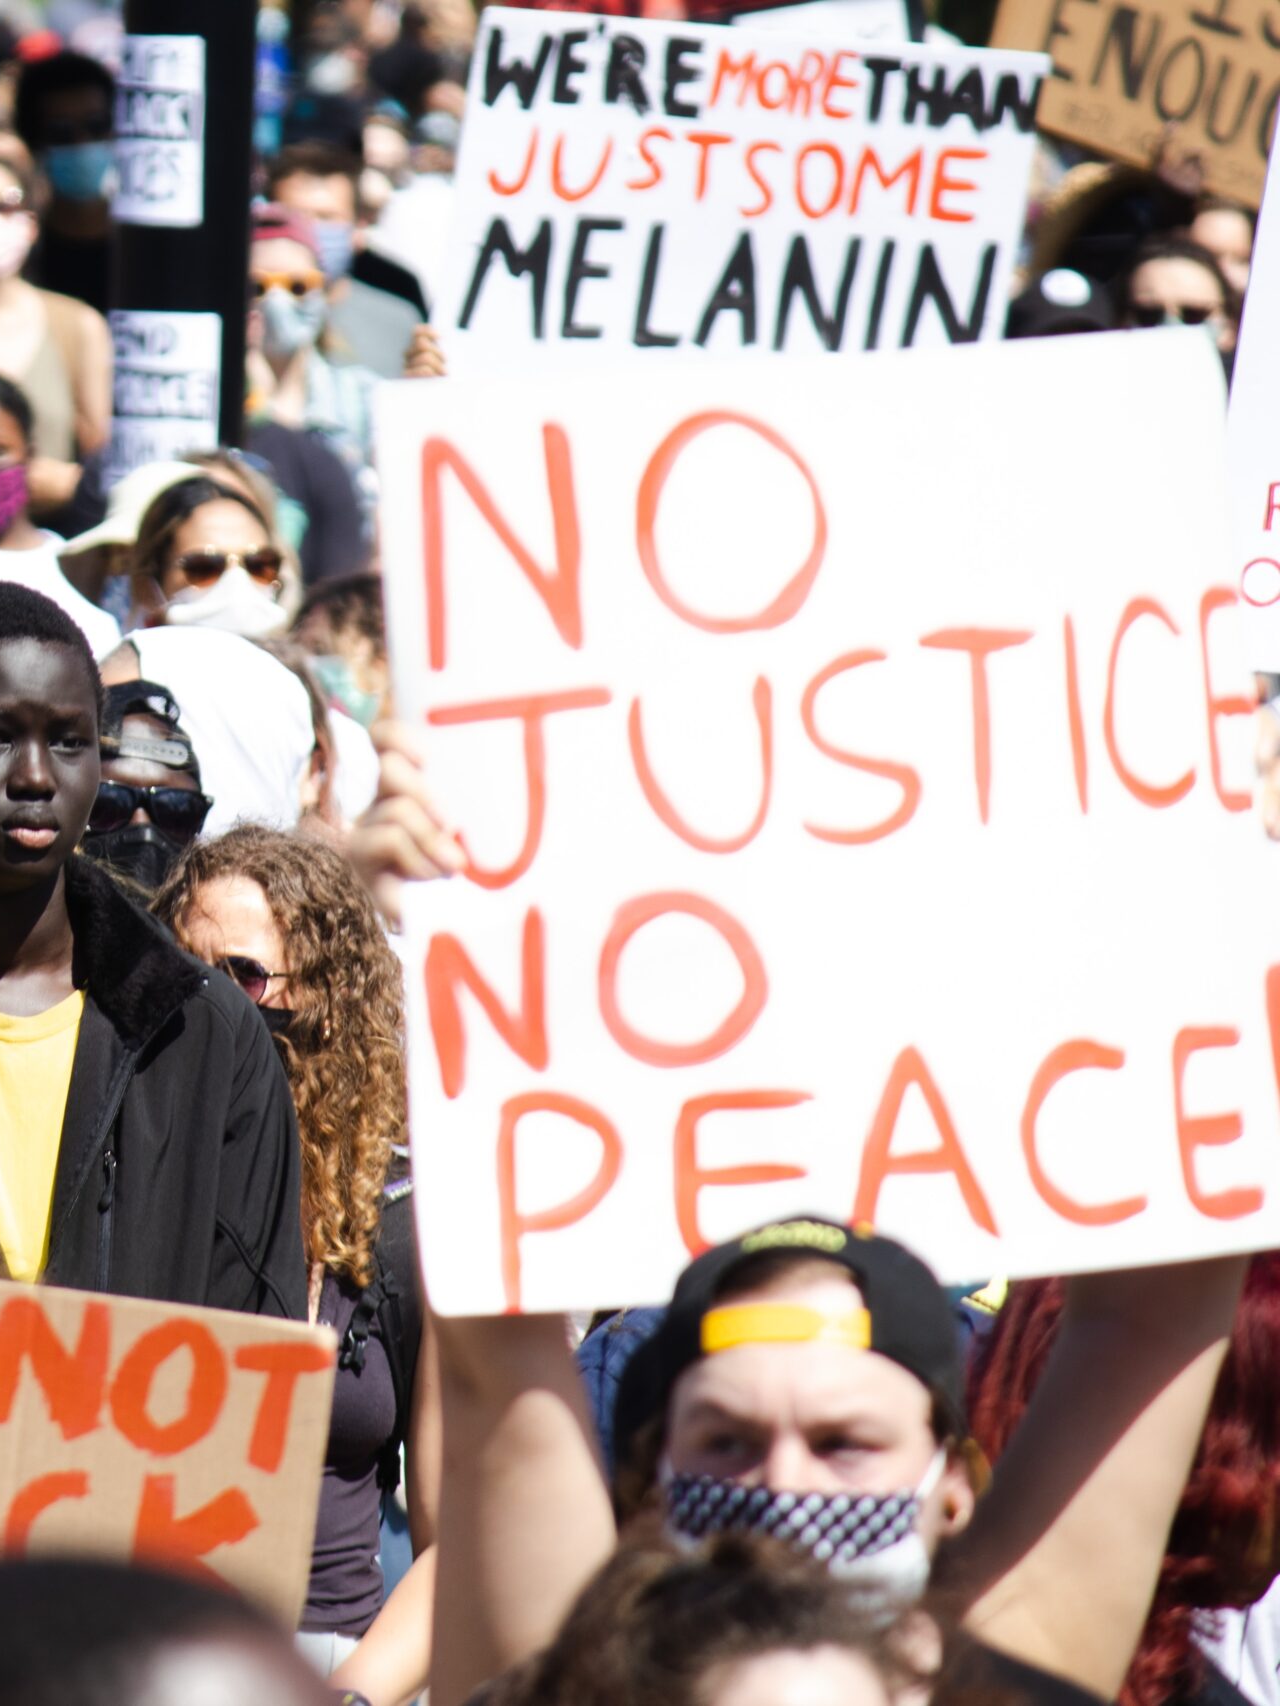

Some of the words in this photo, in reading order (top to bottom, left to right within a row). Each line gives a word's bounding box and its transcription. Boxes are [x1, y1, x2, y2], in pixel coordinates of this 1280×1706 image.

[483, 19, 703, 119] WE'RE
[706, 46, 860, 118] MORE
[863, 56, 1043, 137] THAN
[1043, 0, 1280, 160] ENOU
[488, 127, 732, 203] JUST
[739, 141, 988, 222] SOME
[458, 214, 998, 352] MELANIN
[421, 408, 829, 673] NO
[427, 585, 1259, 890] JUSTICE
[424, 889, 769, 1101] NO
